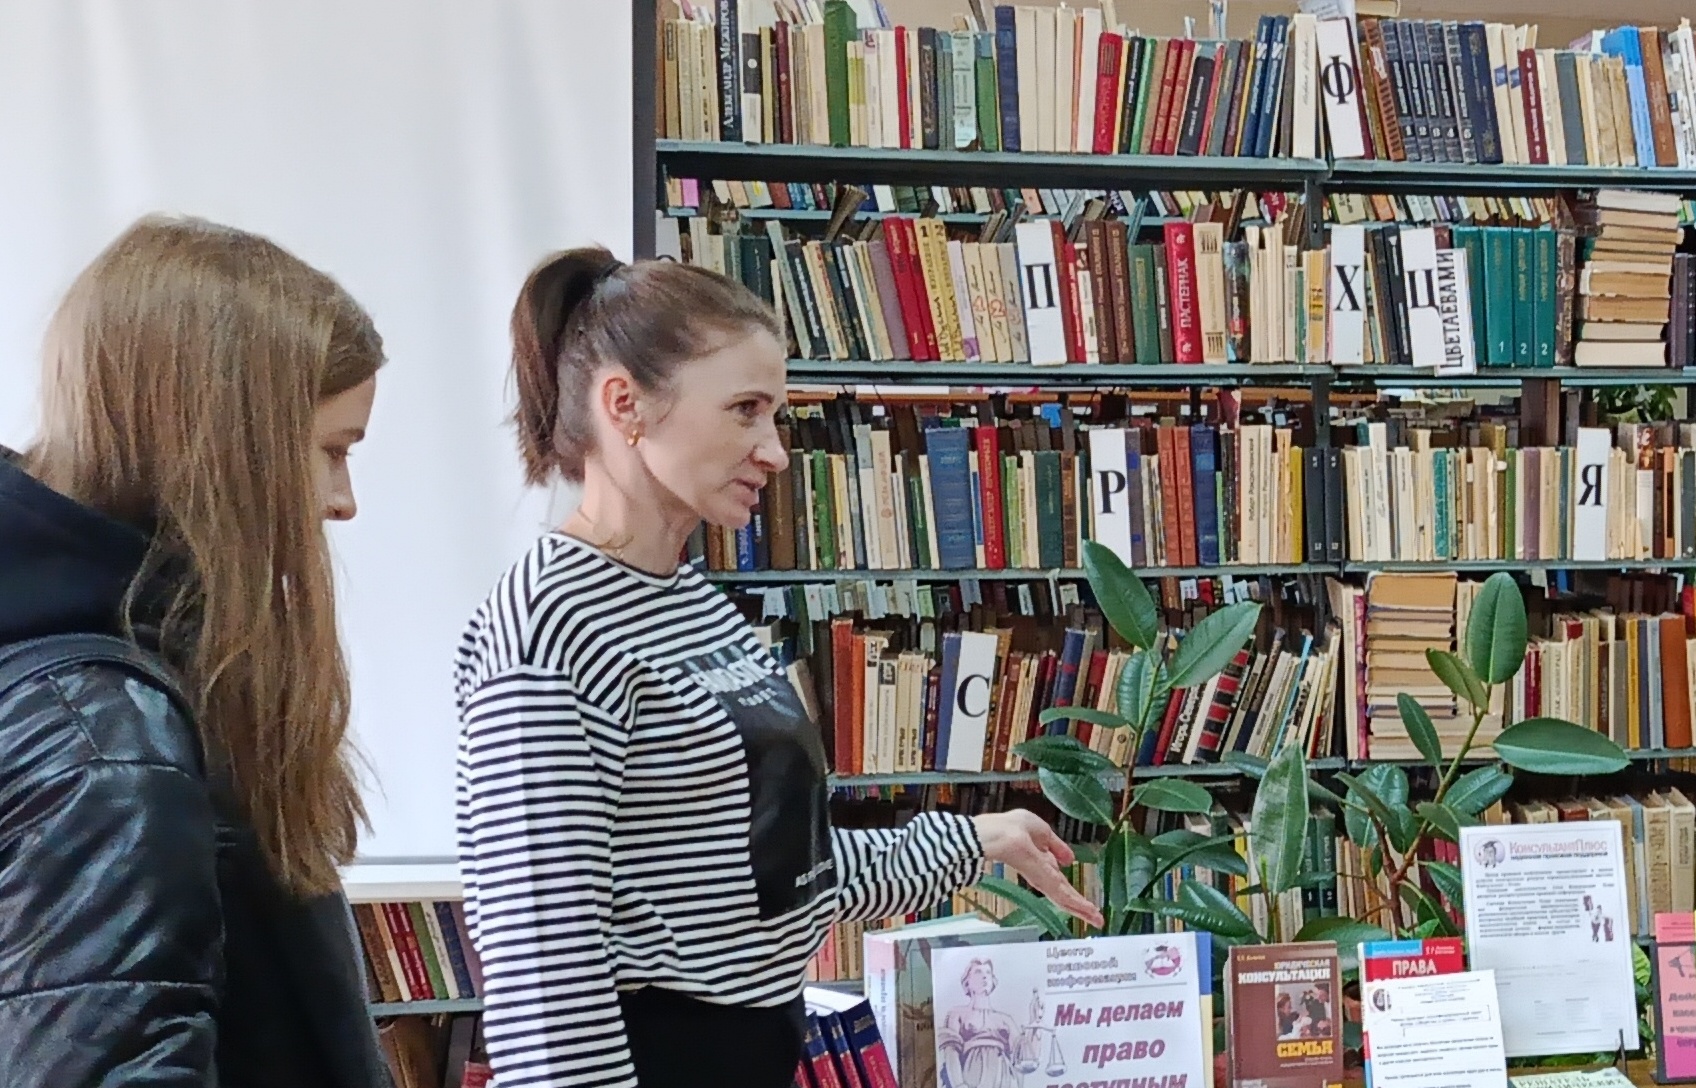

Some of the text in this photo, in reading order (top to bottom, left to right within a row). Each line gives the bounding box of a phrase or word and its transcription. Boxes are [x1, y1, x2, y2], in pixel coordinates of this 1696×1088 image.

[1322, 56, 1354, 104] Ф
[1025, 265, 1055, 309] П
[1177, 258, 1191, 328] ПАСТЕРНАК
[1335, 265, 1360, 311] Х
[1407, 269, 1440, 316] Ц
[1095, 470, 1125, 515] Р
[1578, 462, 1603, 506] Я
[957, 674, 991, 718] С
[1047, 946, 1093, 959] Центр
[1047, 958, 1118, 974] правовой
[1274, 959, 1330, 969] ЮРИДИЧЕСКАЯ
[1392, 958, 1437, 976] ПРАВА
[1047, 972, 1137, 988] информации
[1238, 968, 1331, 984] КОНСУЛЬТАЦИЯ
[1054, 1000, 1184, 1028] Мы делаем
[1082, 1038, 1165, 1069] право
[1277, 1040, 1333, 1057] СЕМЬЯ
